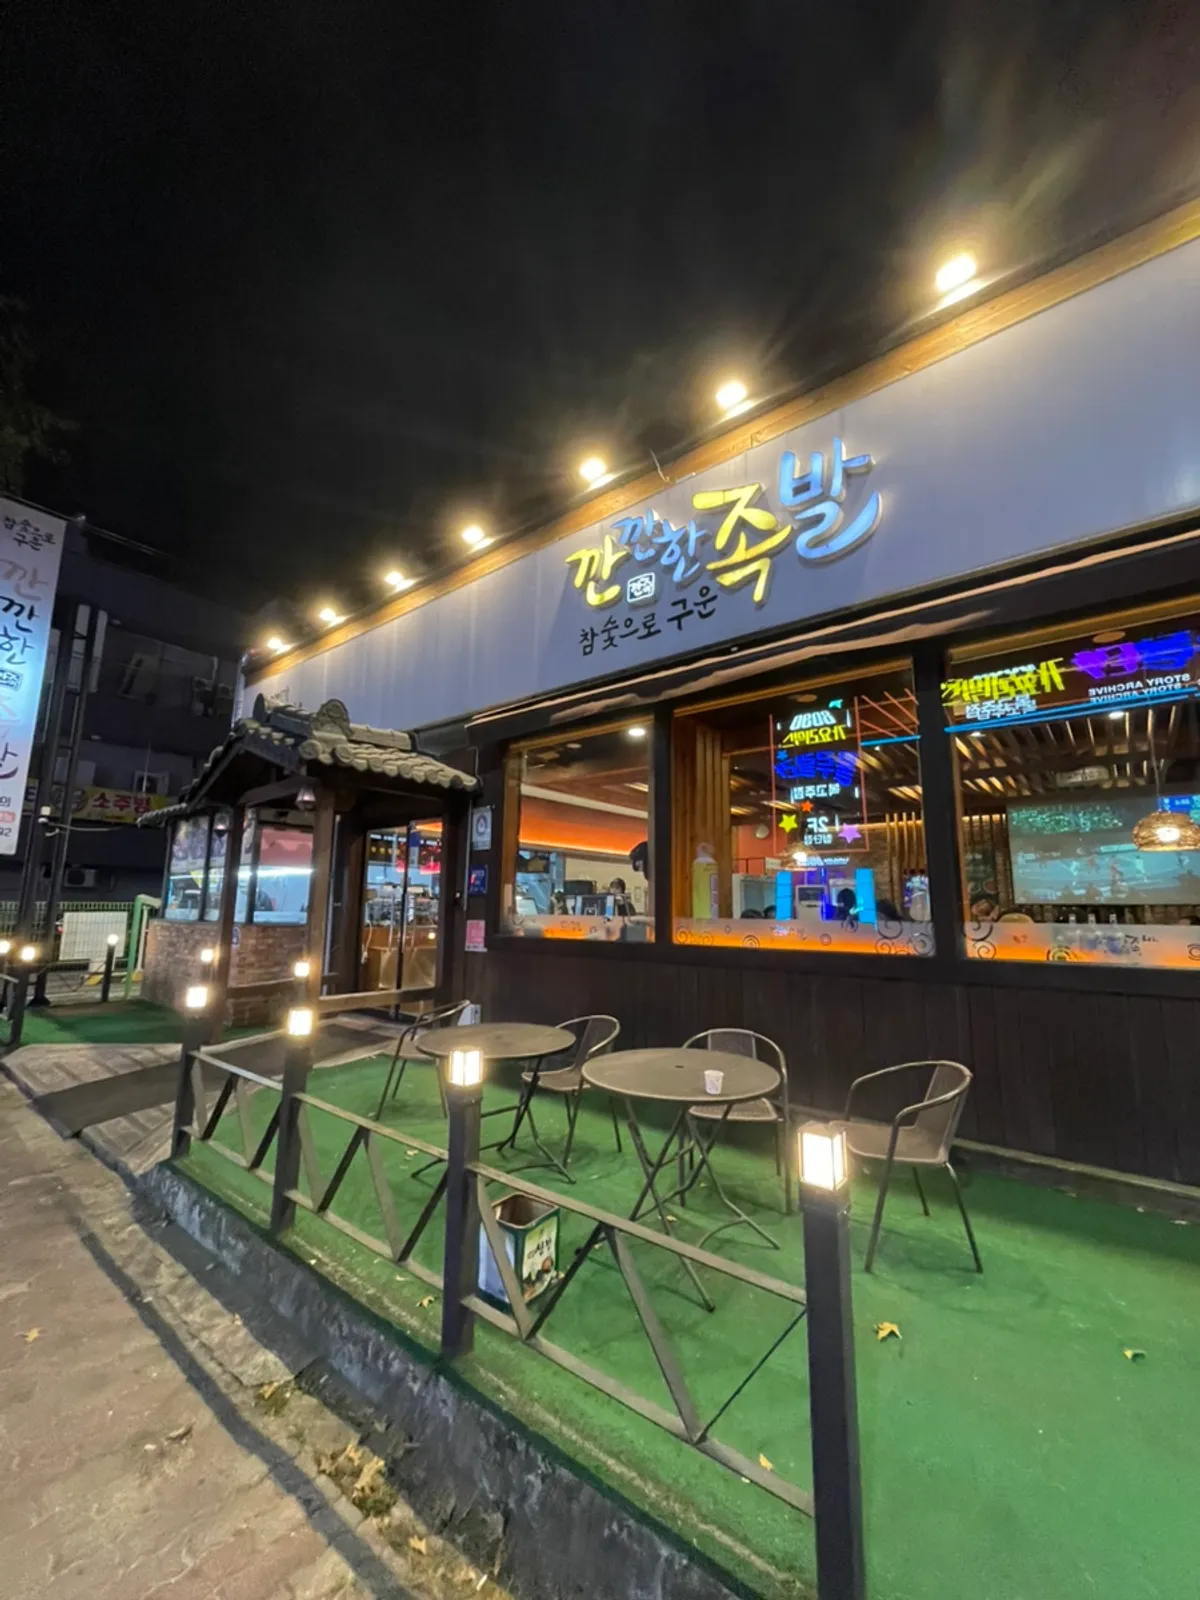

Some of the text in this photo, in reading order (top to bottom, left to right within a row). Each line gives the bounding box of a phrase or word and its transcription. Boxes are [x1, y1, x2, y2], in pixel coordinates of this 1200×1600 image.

[565, 436, 882, 606] 깐깐한 족발
[578, 586, 718, 656] 참숯으로 구운
